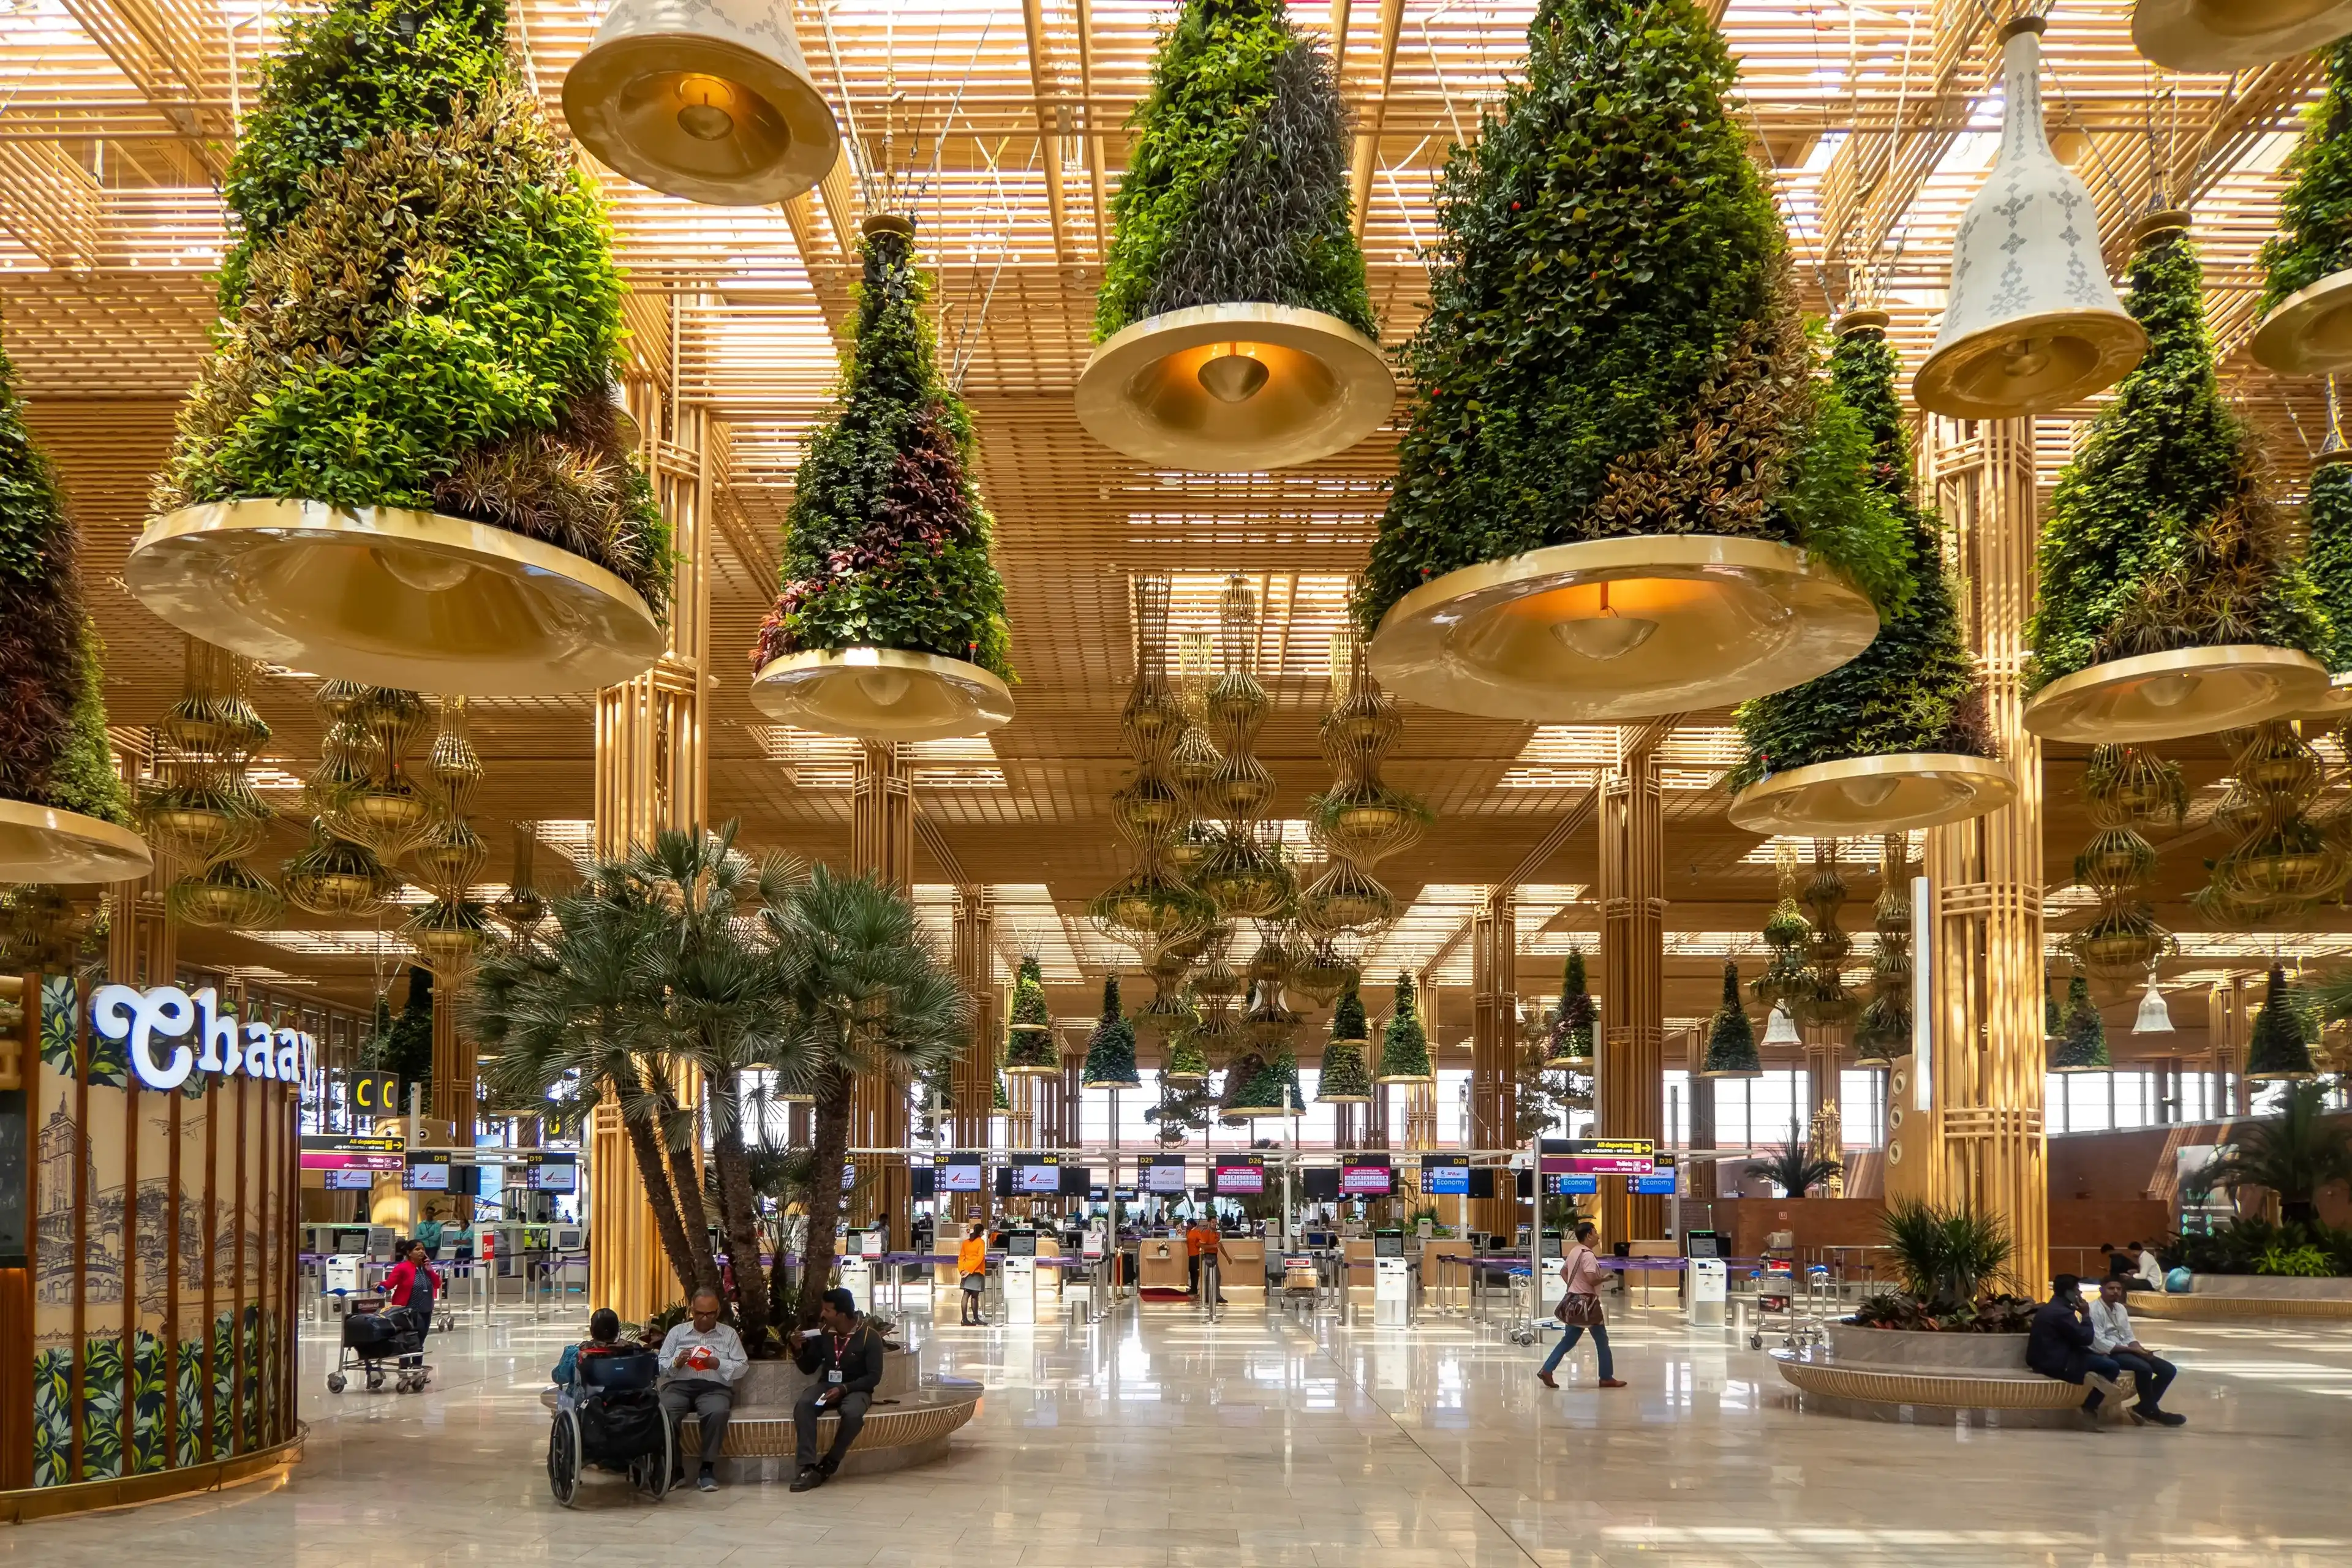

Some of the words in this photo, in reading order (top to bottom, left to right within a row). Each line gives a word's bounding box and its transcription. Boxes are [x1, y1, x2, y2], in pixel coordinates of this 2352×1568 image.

[96, 984, 317, 1102] Chaay
[357, 1079, 372, 1107] C
[383, 1081, 394, 1108] C
